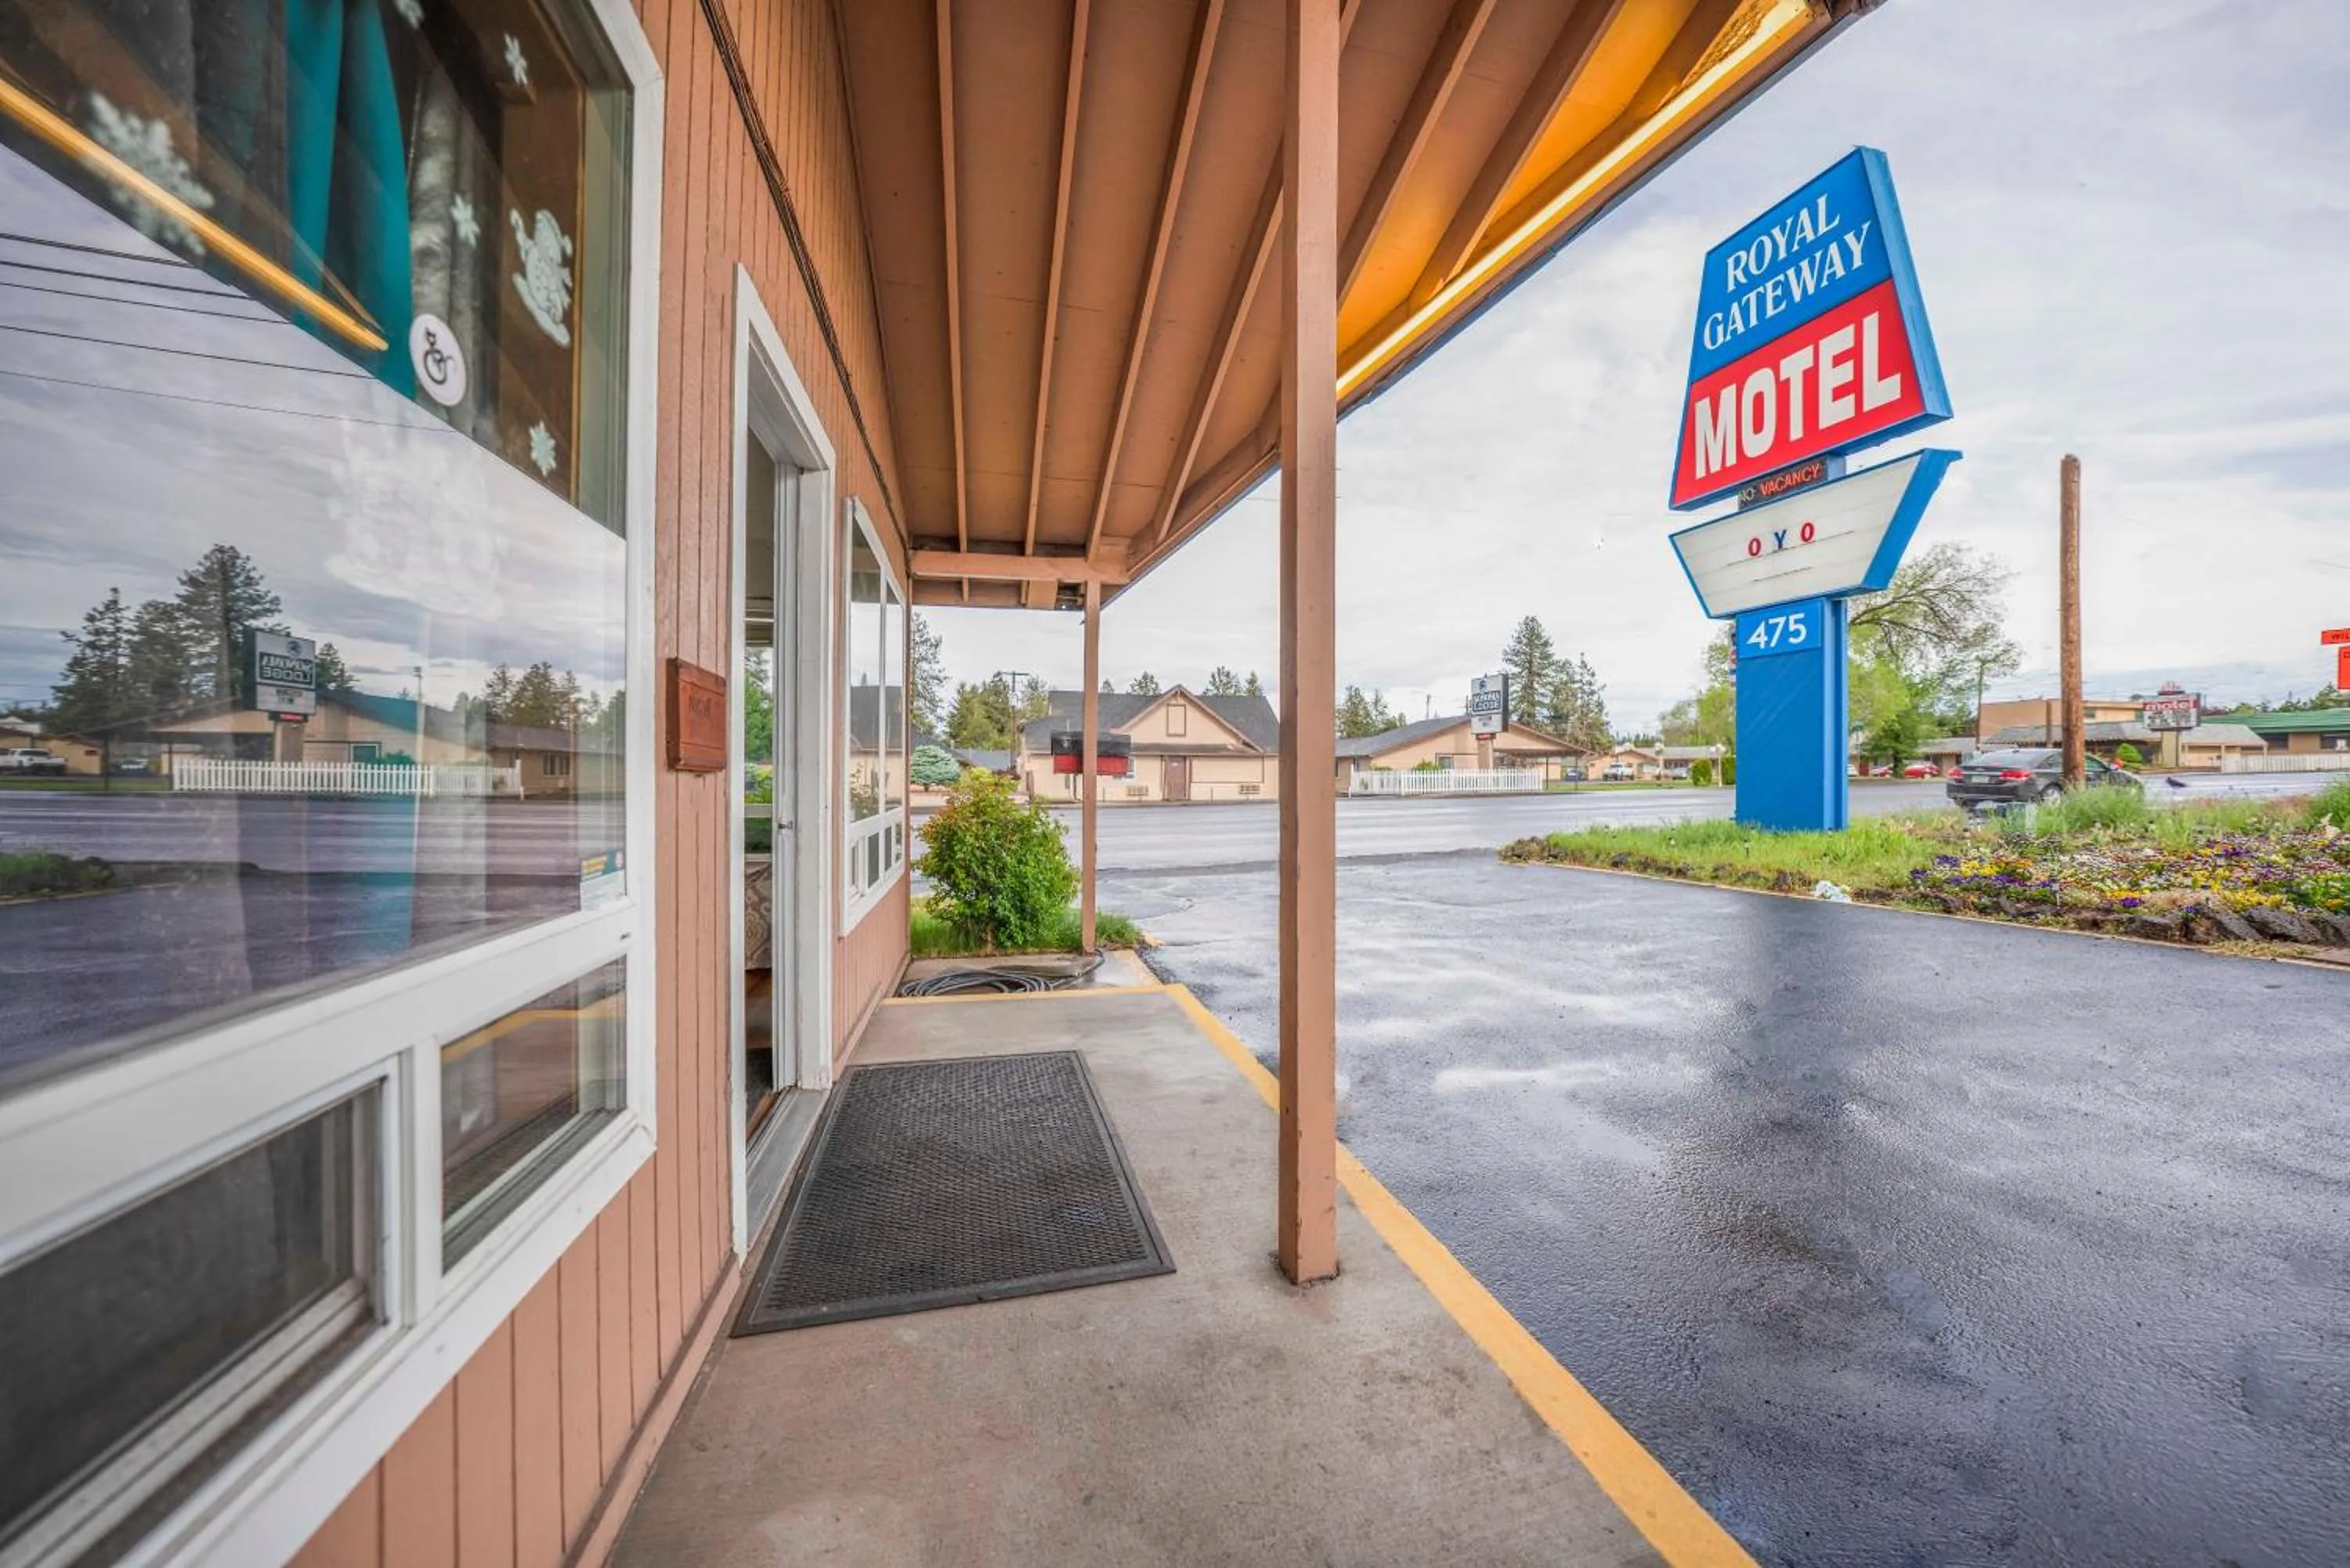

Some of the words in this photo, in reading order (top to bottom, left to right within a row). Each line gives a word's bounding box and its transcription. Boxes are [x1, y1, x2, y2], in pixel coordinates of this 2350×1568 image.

[1703, 220, 1871, 350] GATEWAY
[1727, 193, 1840, 293] ROYAL
[1694, 311, 1901, 479] MOTEL
[1760, 463, 1820, 495] VACANCY
[1747, 613, 1807, 649] 475
